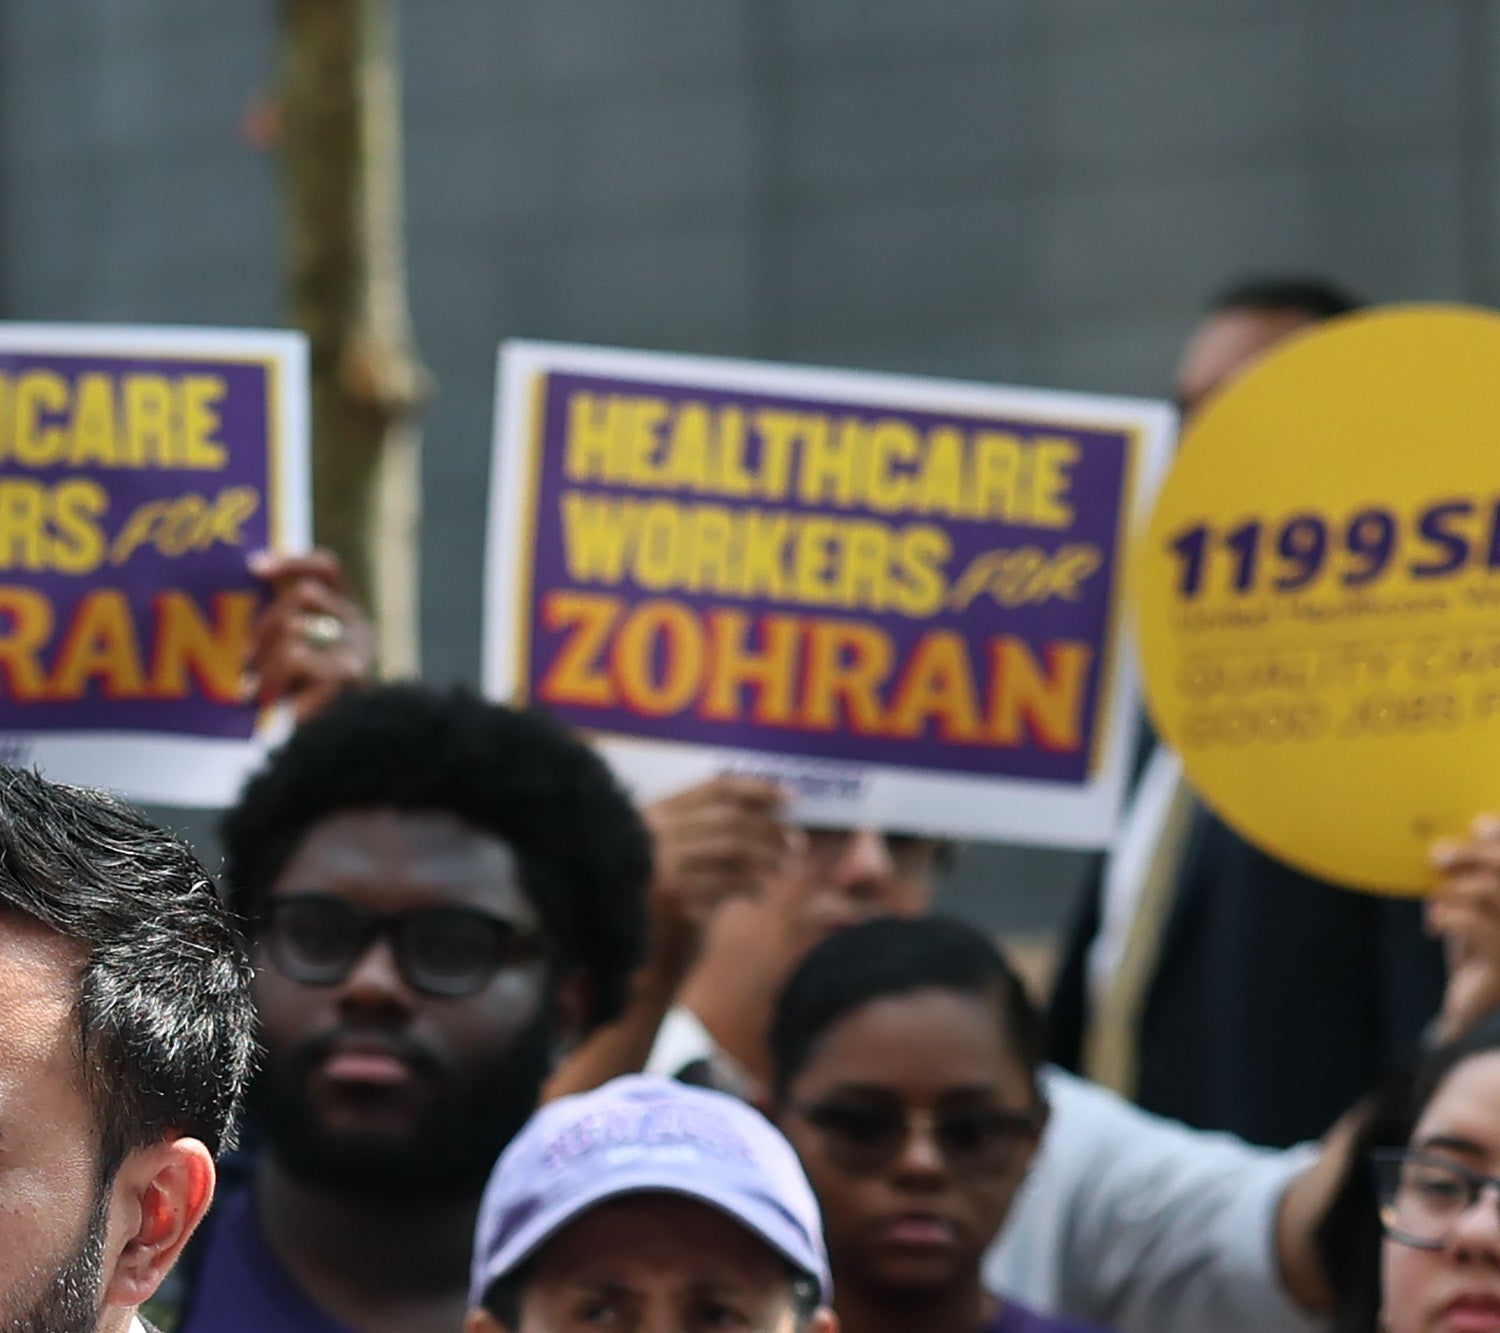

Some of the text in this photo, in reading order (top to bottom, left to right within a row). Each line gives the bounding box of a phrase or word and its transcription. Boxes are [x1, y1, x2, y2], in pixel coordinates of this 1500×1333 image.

[110, 484, 260, 566] FOR
[564, 389, 1081, 529] HEALTHCARE
[559, 491, 954, 618] WORKERS
[536, 588, 1093, 755] ZOHRAN
